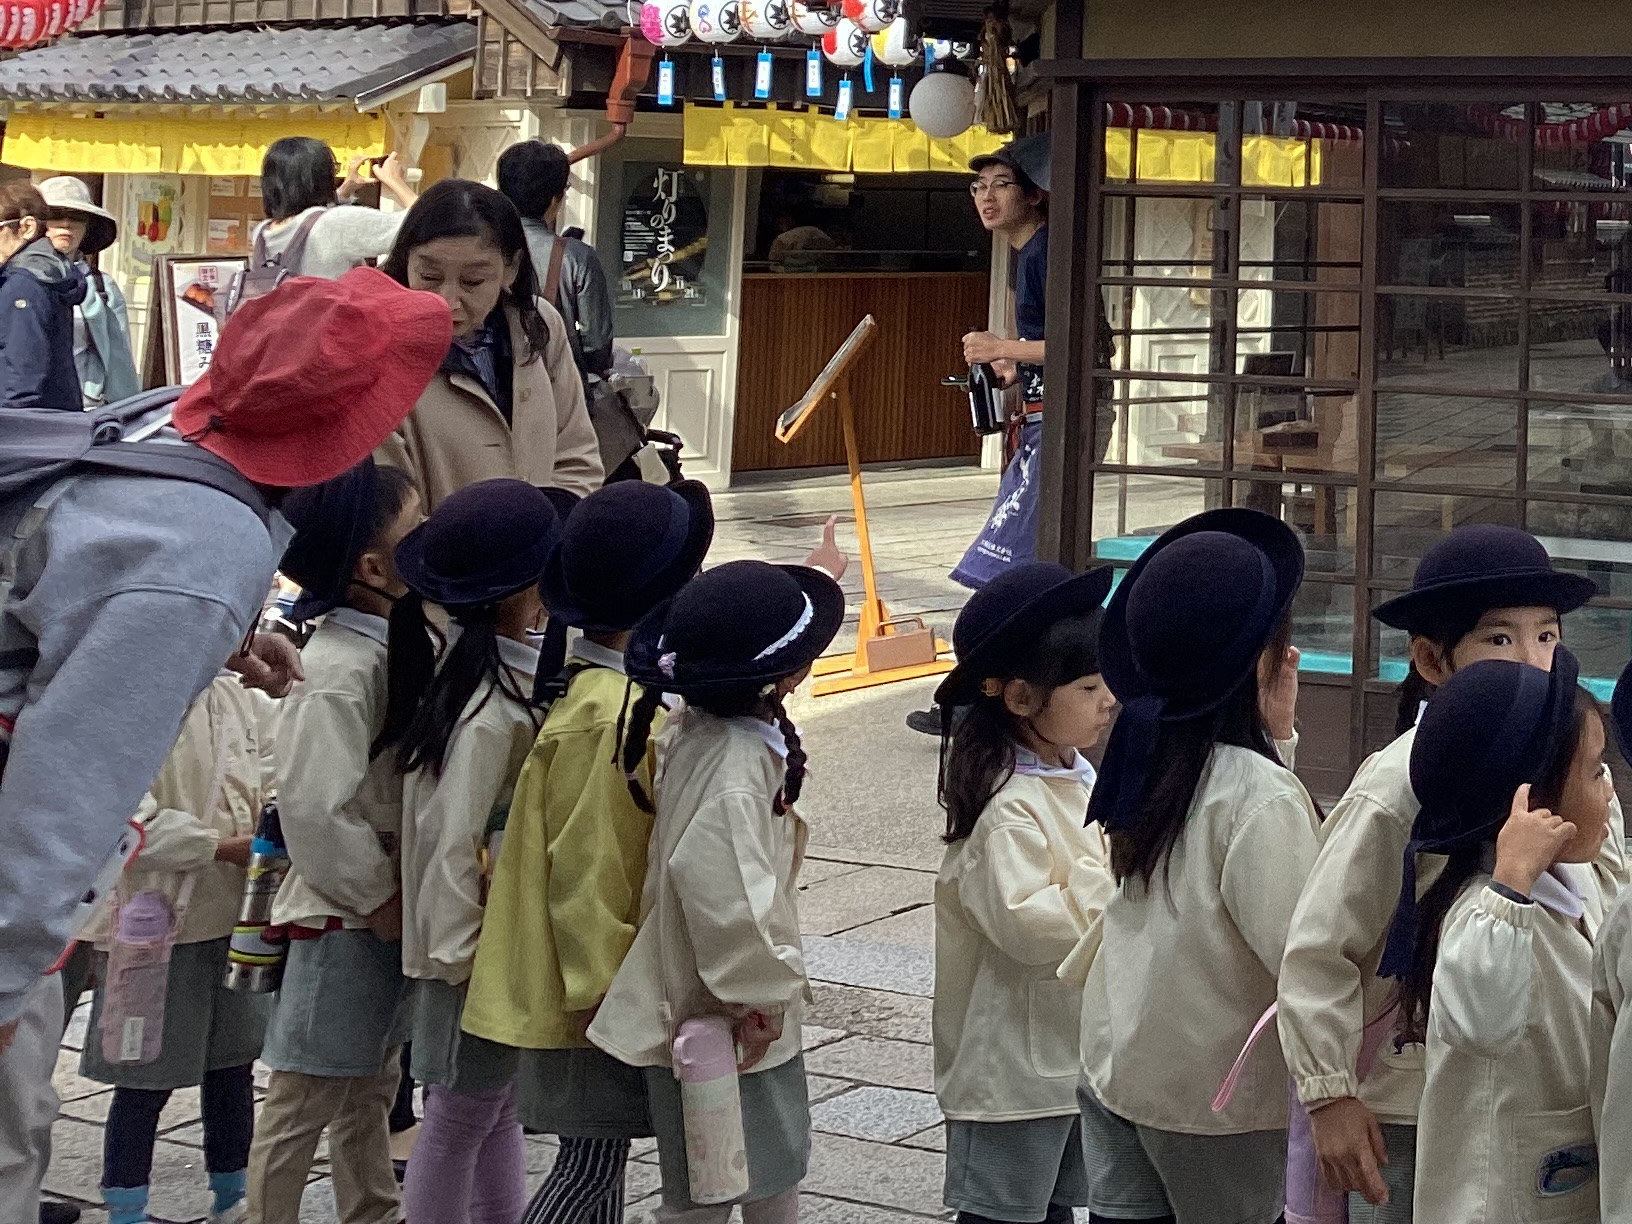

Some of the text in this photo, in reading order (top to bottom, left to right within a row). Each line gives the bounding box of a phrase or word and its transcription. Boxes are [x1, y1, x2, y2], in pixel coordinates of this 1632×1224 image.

[651, 167, 685, 293] 灯りのまつり
